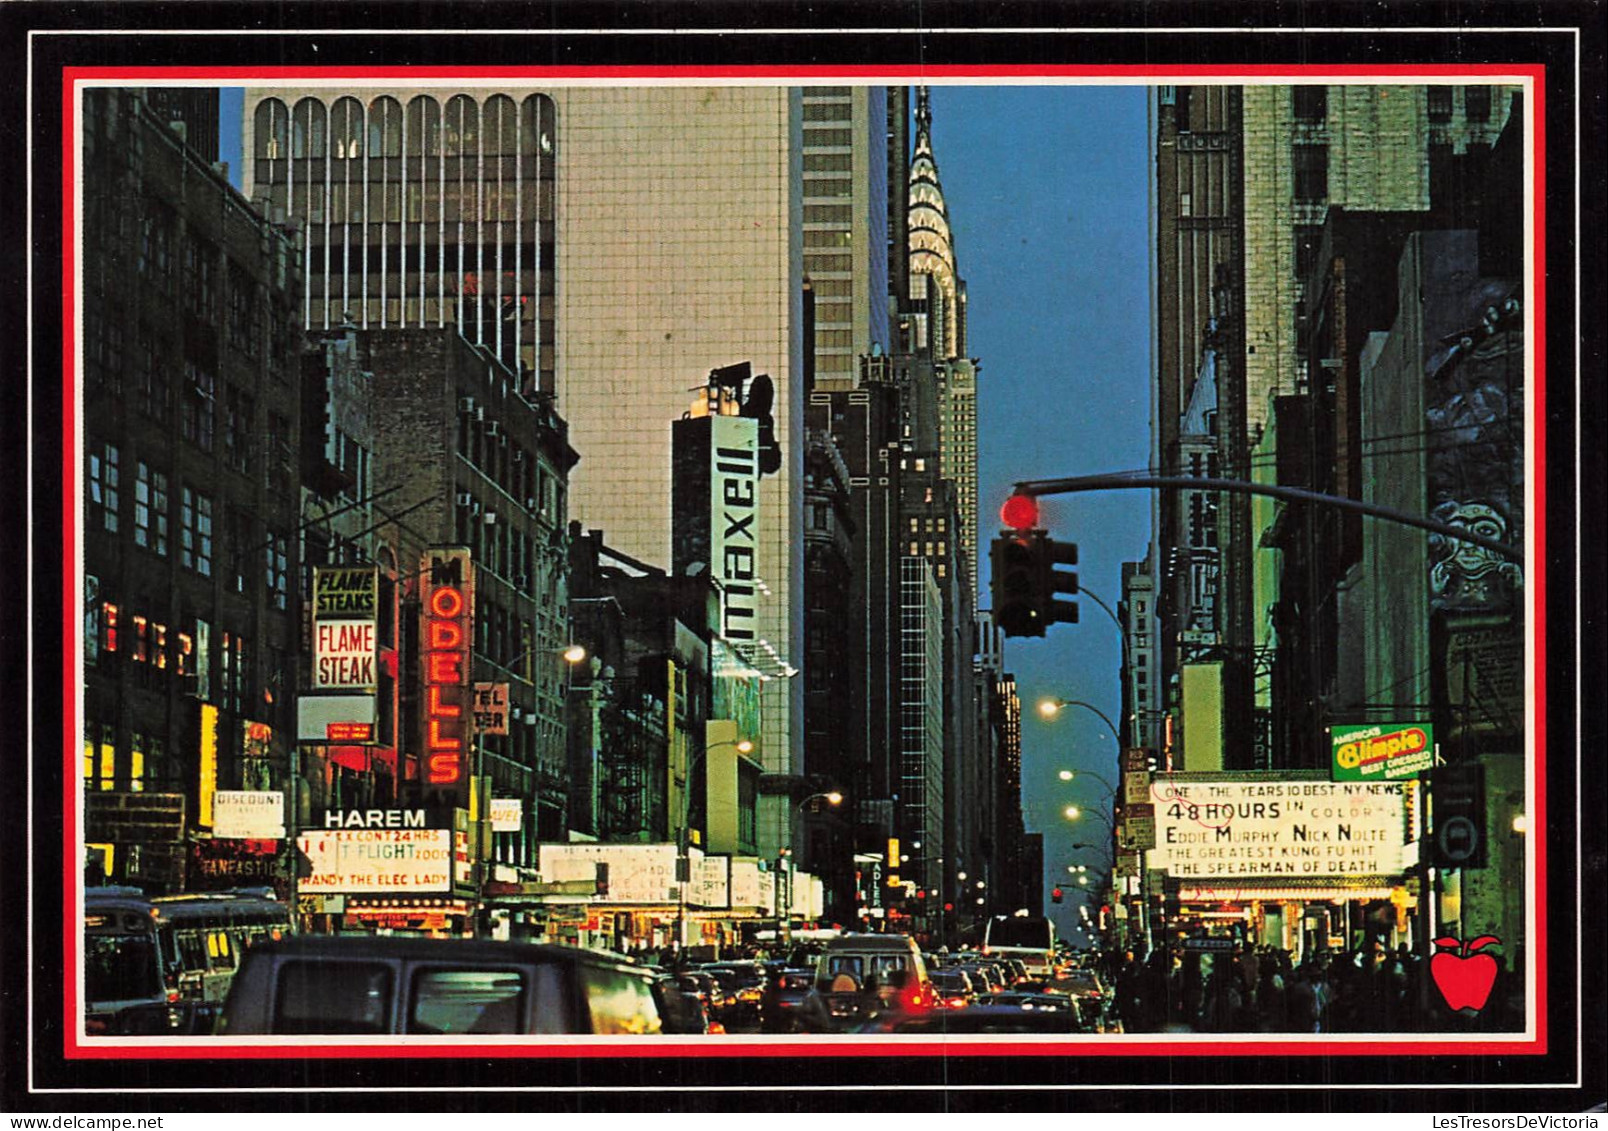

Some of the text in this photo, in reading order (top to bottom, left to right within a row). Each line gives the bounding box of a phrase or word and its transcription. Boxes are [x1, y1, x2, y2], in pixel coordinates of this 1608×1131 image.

[717, 447, 754, 640] maxell
[318, 572, 373, 591] FLAME
[317, 593, 374, 611] STEAKS
[319, 625, 373, 652] FLAME
[319, 656, 373, 685] STEAK
[427, 556, 464, 784] MODELLS
[1337, 730, 1422, 769] Blimpie
[1165, 787, 1191, 797] ONE
[1209, 787, 1232, 797] THE
[1240, 786, 1284, 797] YEARS
[1303, 785, 1335, 796] BEST
[1344, 785, 1362, 795] NY
[1366, 784, 1404, 796] NEWS
[218, 794, 281, 805] DISCOUNT
[1286, 801, 1303, 811] IN
[325, 809, 426, 828] HAREM
[1167, 803, 1199, 820] 48
[1206, 803, 1281, 819] HOURS
[358, 844, 414, 859] FLIGHT
[1168, 845, 1374, 858] THE GREATEST KUNG FU HIT
[1174, 861, 1378, 874] THE SPEARMAN OF DEATH
[350, 874, 374, 885] THE
[378, 874, 408, 885] ELEC
[414, 874, 447, 885] LADY
